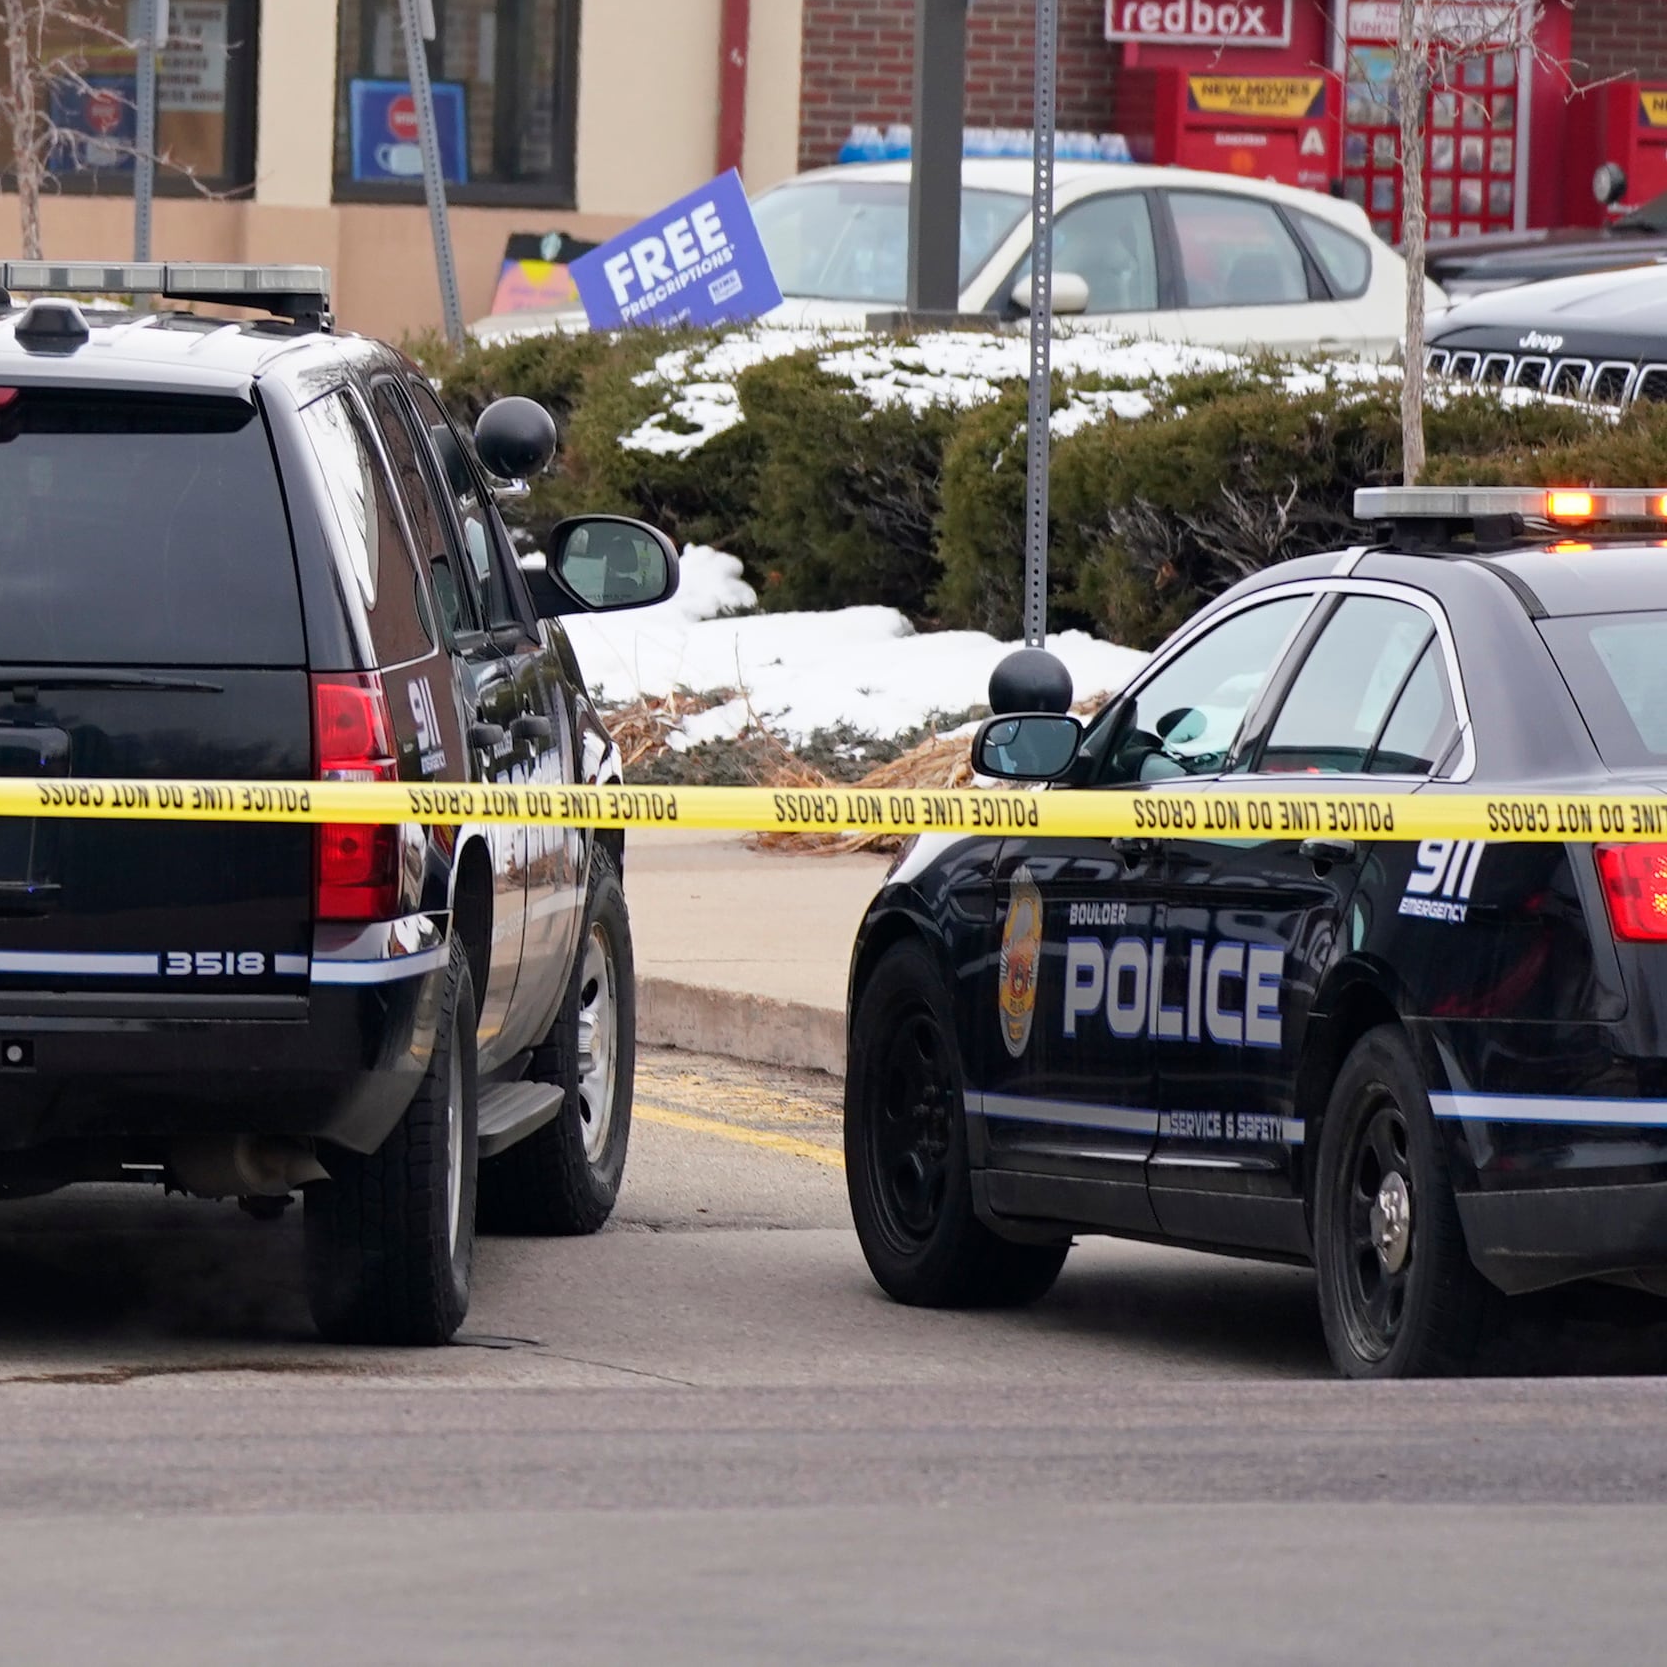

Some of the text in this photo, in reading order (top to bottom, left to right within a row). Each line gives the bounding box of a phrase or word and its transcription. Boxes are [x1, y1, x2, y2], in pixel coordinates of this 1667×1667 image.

[1201, 82, 1242, 96] NEW
[603, 200, 728, 307] FREE
[1518, 330, 1563, 353] Jeep
[409, 788, 678, 821] POLICE LINE DO NOT CROSS
[774, 794, 1038, 828] POLICE LINE DO NOT CROSS
[1134, 799, 1394, 833] POLICE LINE DO NOT CROSS
[1487, 802, 1667, 834] INE DO NOT CROSS
[1405, 839, 1486, 900] 911
[1069, 901, 1128, 926] BOULDER
[1397, 896, 1468, 924] EMERGENCY
[167, 951, 266, 976] 3518
[1064, 935, 1284, 1049] POLICE
[1169, 1110, 1222, 1139] SERVICE
